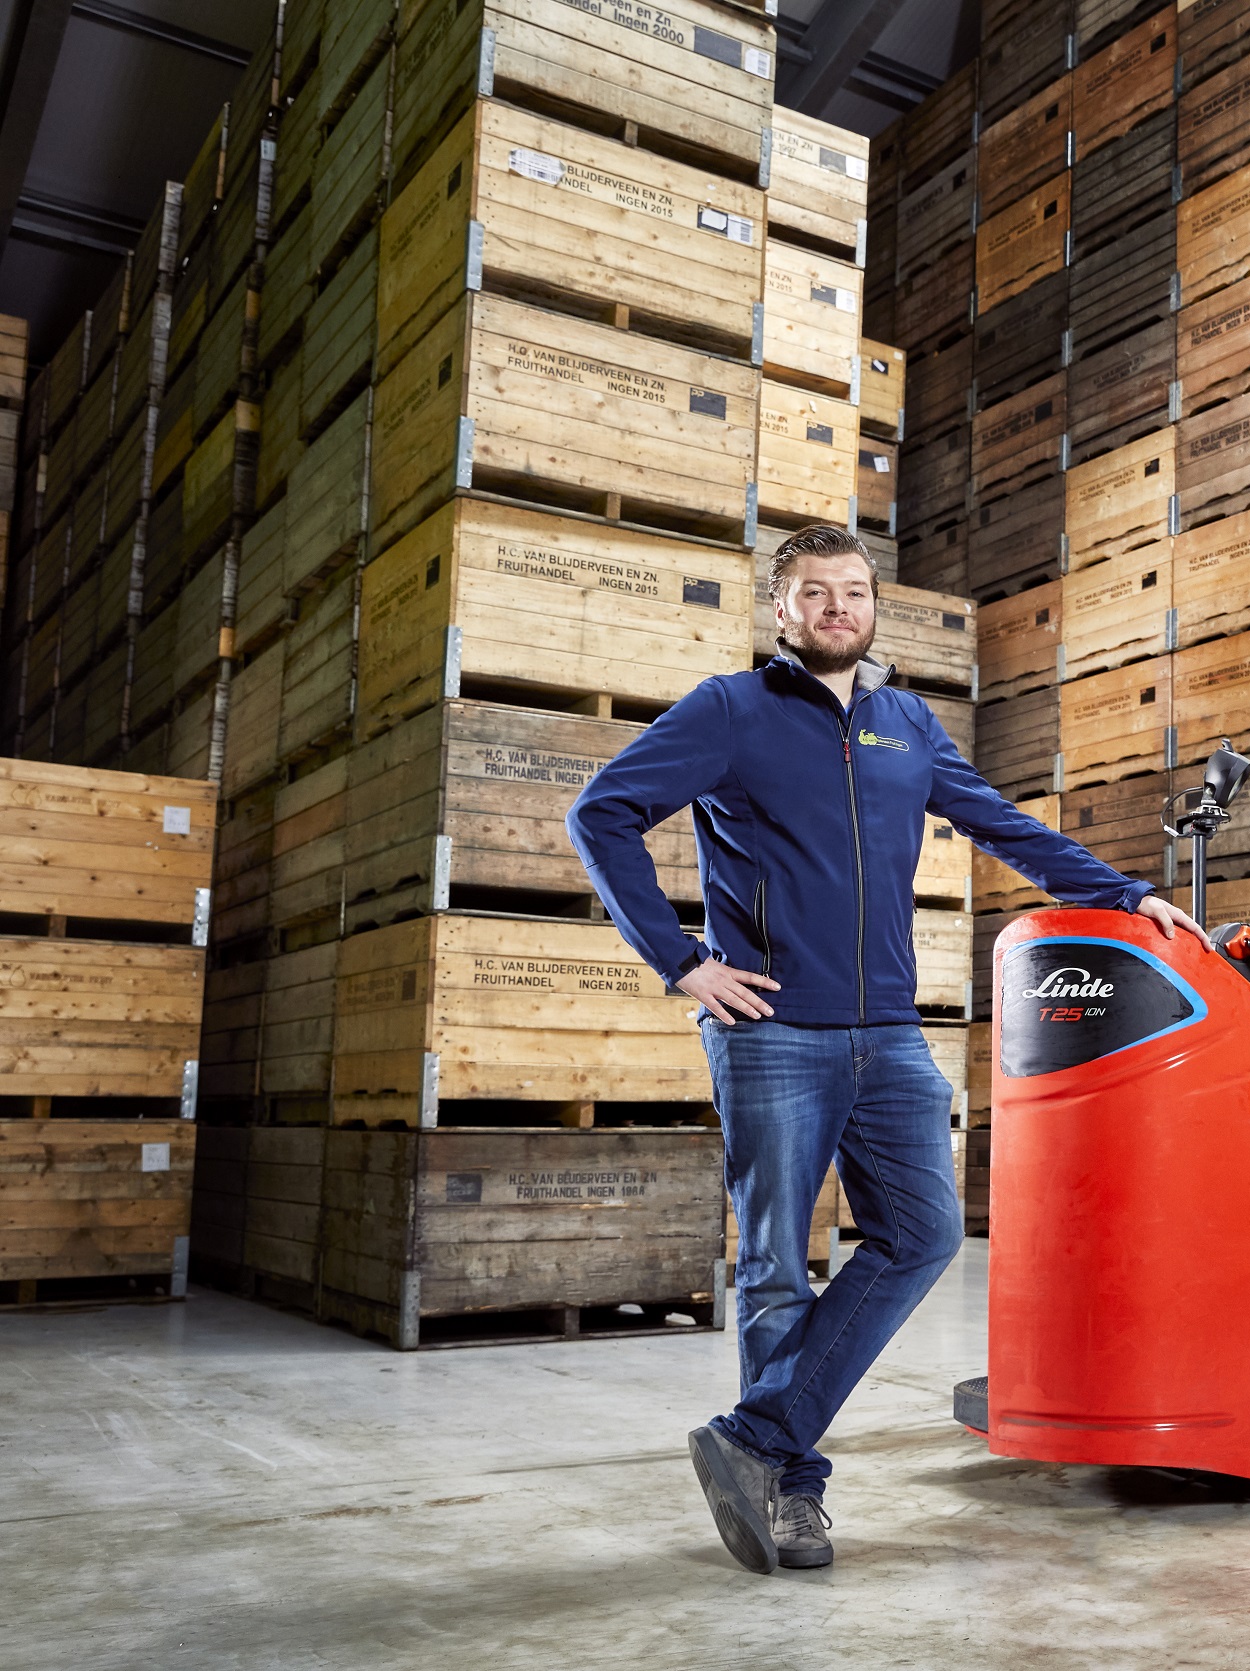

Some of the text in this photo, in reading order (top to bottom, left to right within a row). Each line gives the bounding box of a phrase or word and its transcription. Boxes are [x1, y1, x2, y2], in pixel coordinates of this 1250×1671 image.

[614, 10, 685, 45] Ingen 2000
[637, 6, 653, 20] en
[567, 165, 640, 196] BLIJDERVEEN
[642, 186, 656, 201] EN
[659, 190, 675, 207] ZN.
[615, 192, 674, 218] INGEN 2015
[508, 356, 666, 403] FRUITHANDEL INGEN 2015
[534, 350, 668, 392] VAN BLIJDERVEEN EN ZN.
[497, 559, 658, 595] FRUITHANDEL INGEN 2015
[498, 545, 660, 583] H.C. VAN BLIJDERVEEN EN ZN.
[485, 748, 594, 776] H.C. VAN BLIJDERVEEN
[485, 763, 585, 786] FRUITHANDEL INGEN
[474, 974, 640, 992] FRUITHANDEL INGEN 2015
[475, 959, 642, 979] H.C. VAN BLIJDERVEEN EN ZN.
[1023, 967, 1113, 998] Linde
[1085, 1007, 1107, 1016] ION
